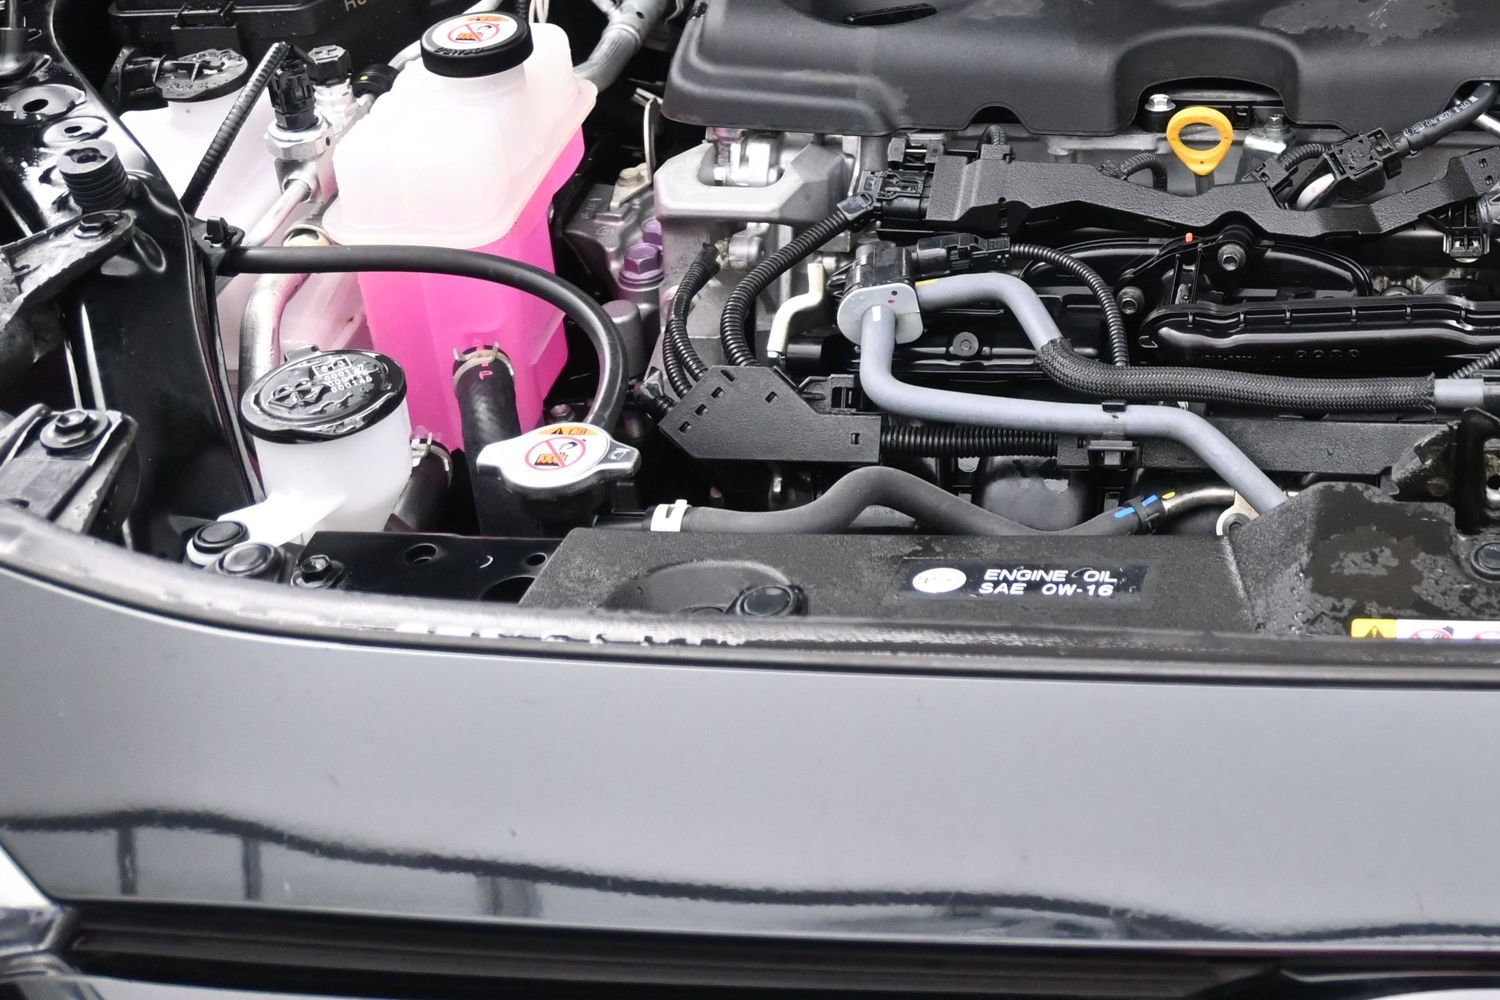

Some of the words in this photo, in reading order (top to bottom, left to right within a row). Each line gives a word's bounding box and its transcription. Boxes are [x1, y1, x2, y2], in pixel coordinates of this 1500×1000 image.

[984, 568, 1068, 581] ENGINE
[1083, 570, 1117, 582] OIL
[979, 583, 1026, 595] SAE
[1042, 584, 1114, 596] 0W-16
